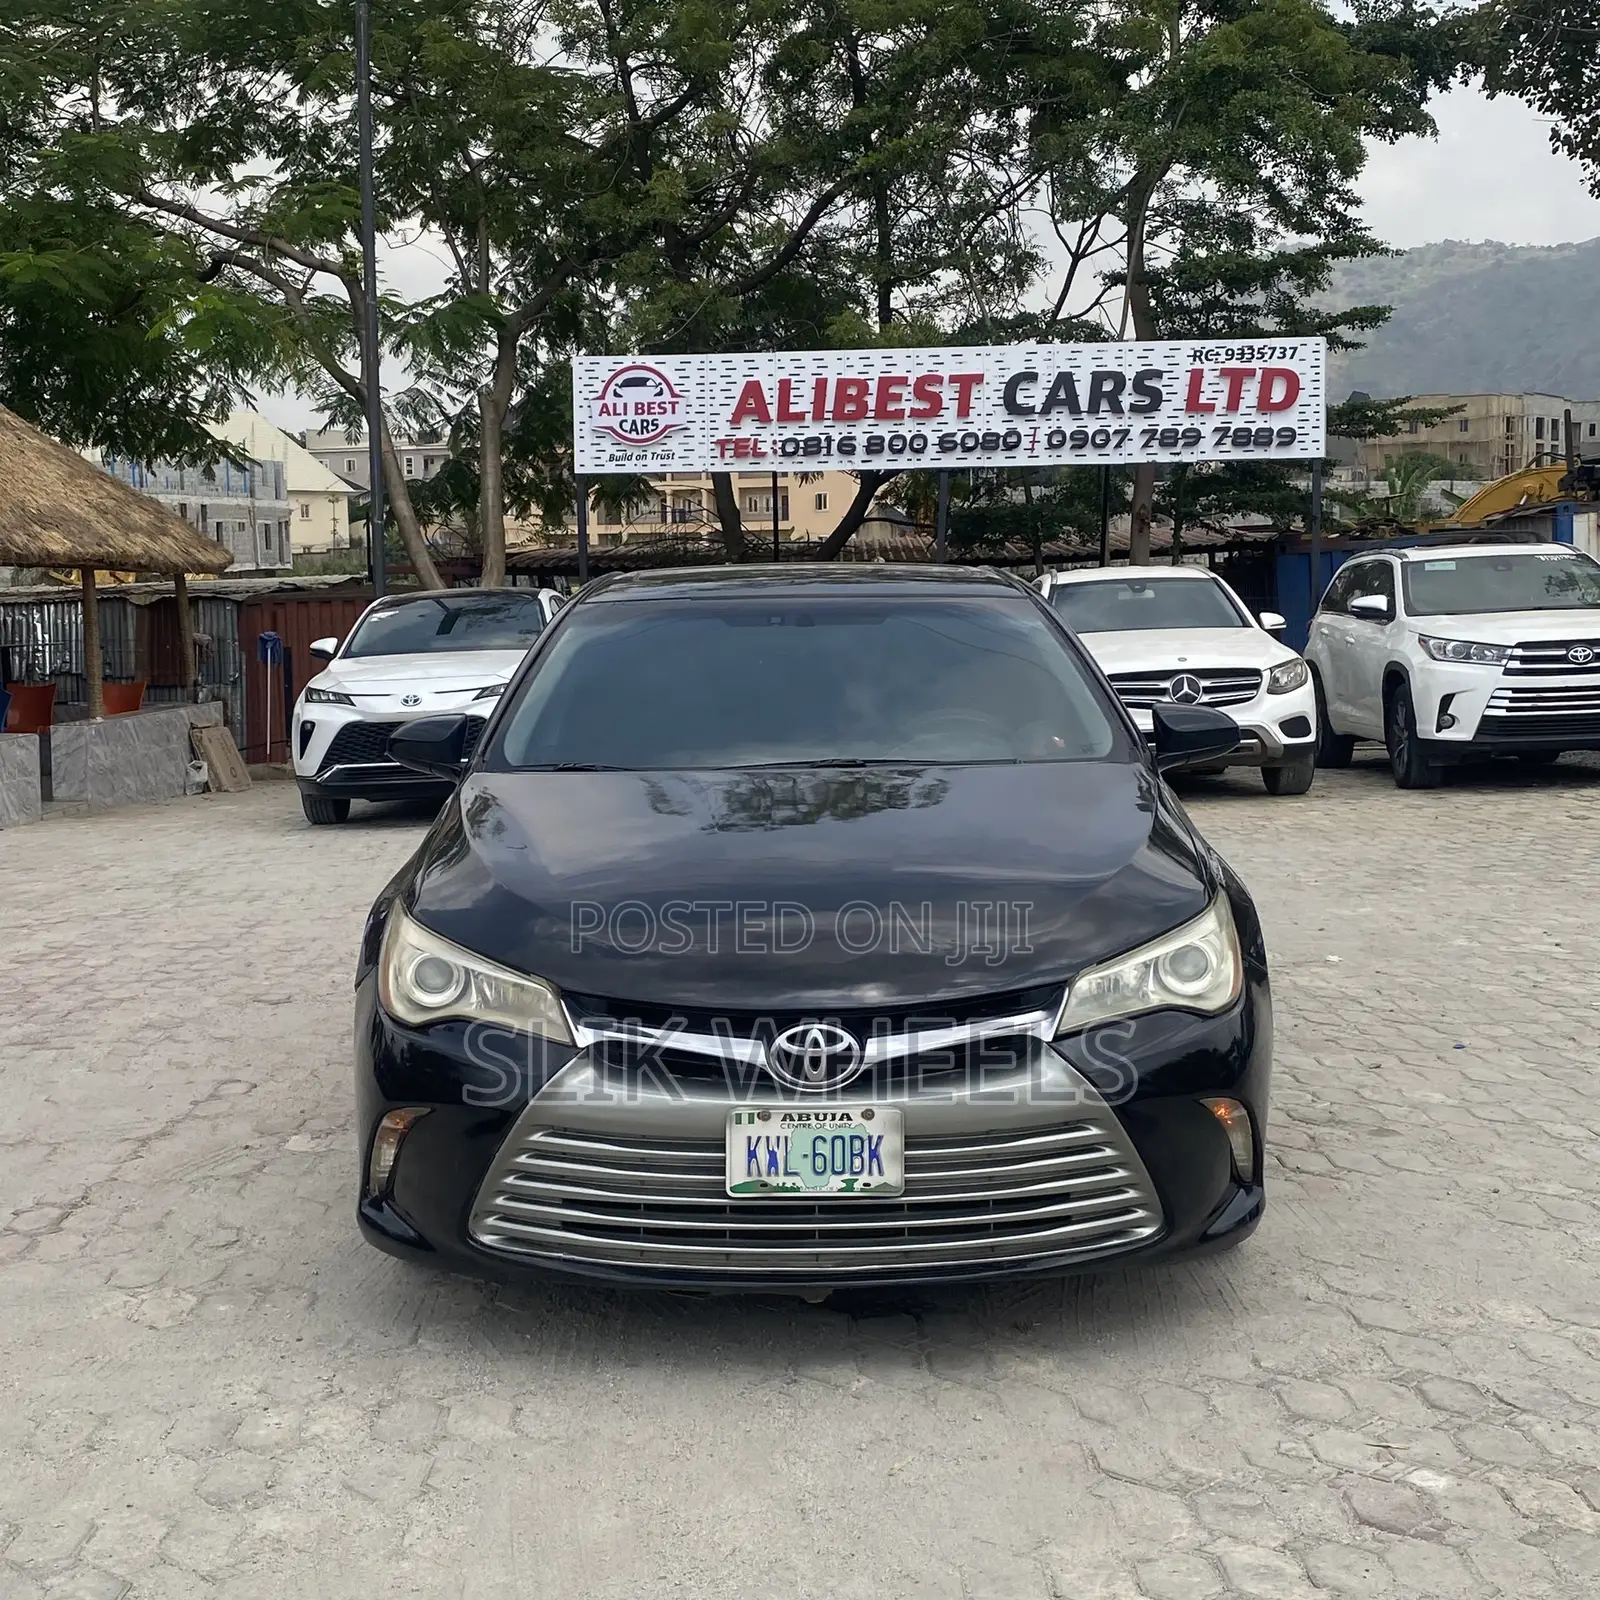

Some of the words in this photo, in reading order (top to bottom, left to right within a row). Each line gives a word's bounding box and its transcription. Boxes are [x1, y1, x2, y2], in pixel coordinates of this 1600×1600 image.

[729, 372, 984, 424] ALIBEST
[1002, 367, 1163, 415] CARS
[1185, 367, 1301, 413] LTD
[598, 402, 628, 417] ALI
[634, 401, 679, 416] BEST
[619, 418, 659, 435] CARS
[780, 434, 857, 458] 0816
[866, 433, 928, 455] 800
[938, 430, 1022, 453] 6080
[1047, 428, 1131, 450] 0907
[1139, 426, 1202, 450] 789
[1212, 425, 1297, 448] 7889
[608, 452, 634, 462] Build
[635, 453, 648, 461] on
[651, 451, 676, 461] Trust
[780, 1112, 853, 1122] ABUJA
